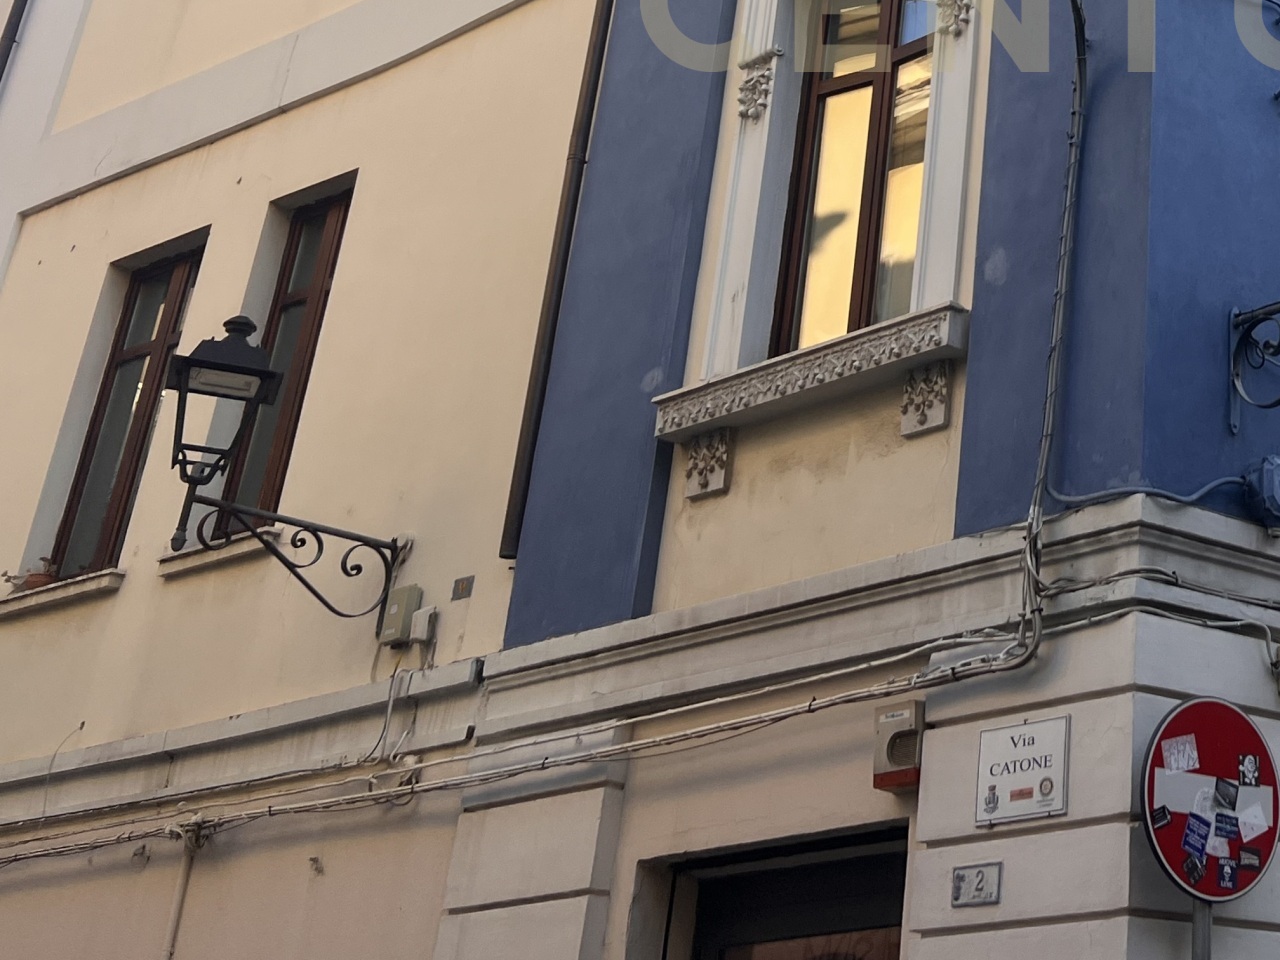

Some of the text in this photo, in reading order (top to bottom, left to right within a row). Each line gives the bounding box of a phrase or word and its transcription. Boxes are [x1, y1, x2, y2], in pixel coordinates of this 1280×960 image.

[1010, 733, 1035, 749] Via
[989, 754, 1053, 777] CATONE
[974, 869, 985, 892] 2
